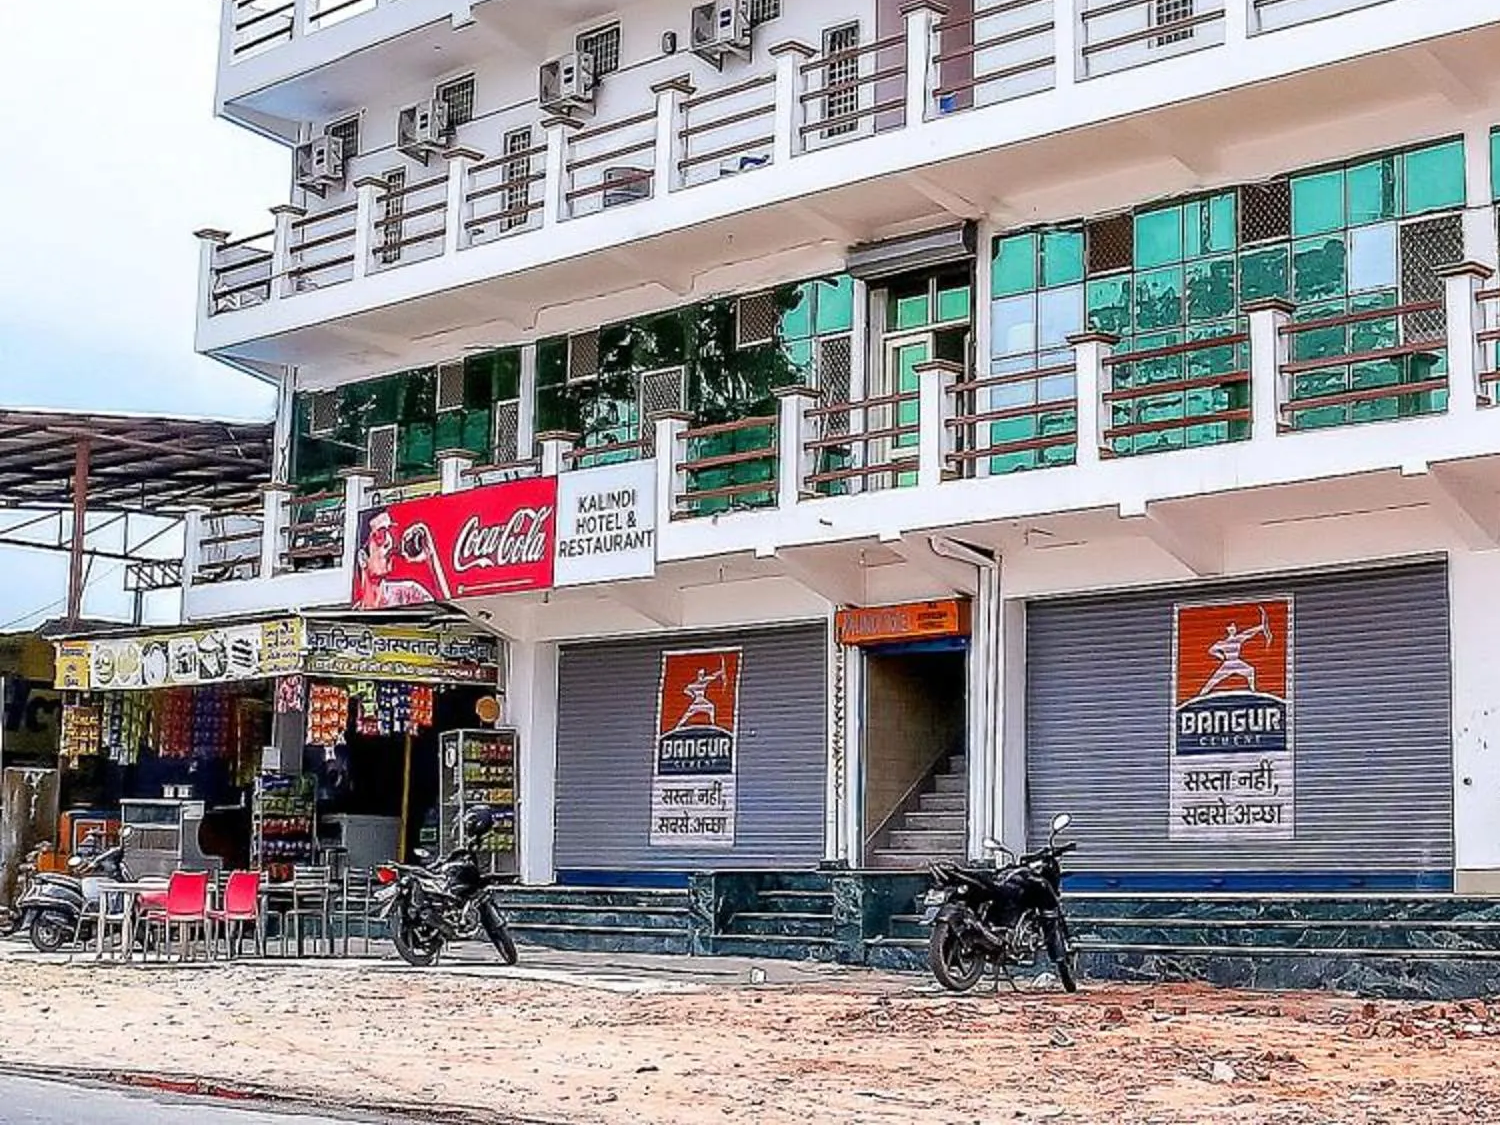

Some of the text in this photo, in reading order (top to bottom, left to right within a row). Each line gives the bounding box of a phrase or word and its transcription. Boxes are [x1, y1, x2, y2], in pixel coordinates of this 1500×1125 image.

[578, 488, 636, 513] KALINDI
[577, 511, 637, 534] HOTEL &
[560, 530, 653, 557] RESTAURANT
[1182, 708, 1281, 734] BANGUR
[662, 739, 730, 759] BANGUR
[1183, 770, 1232, 792] सस्ता
[661, 787, 695, 806] सस्ता
[658, 811, 691, 835] सबसे
[1181, 797, 1283, 826] सबसे अच्छा
